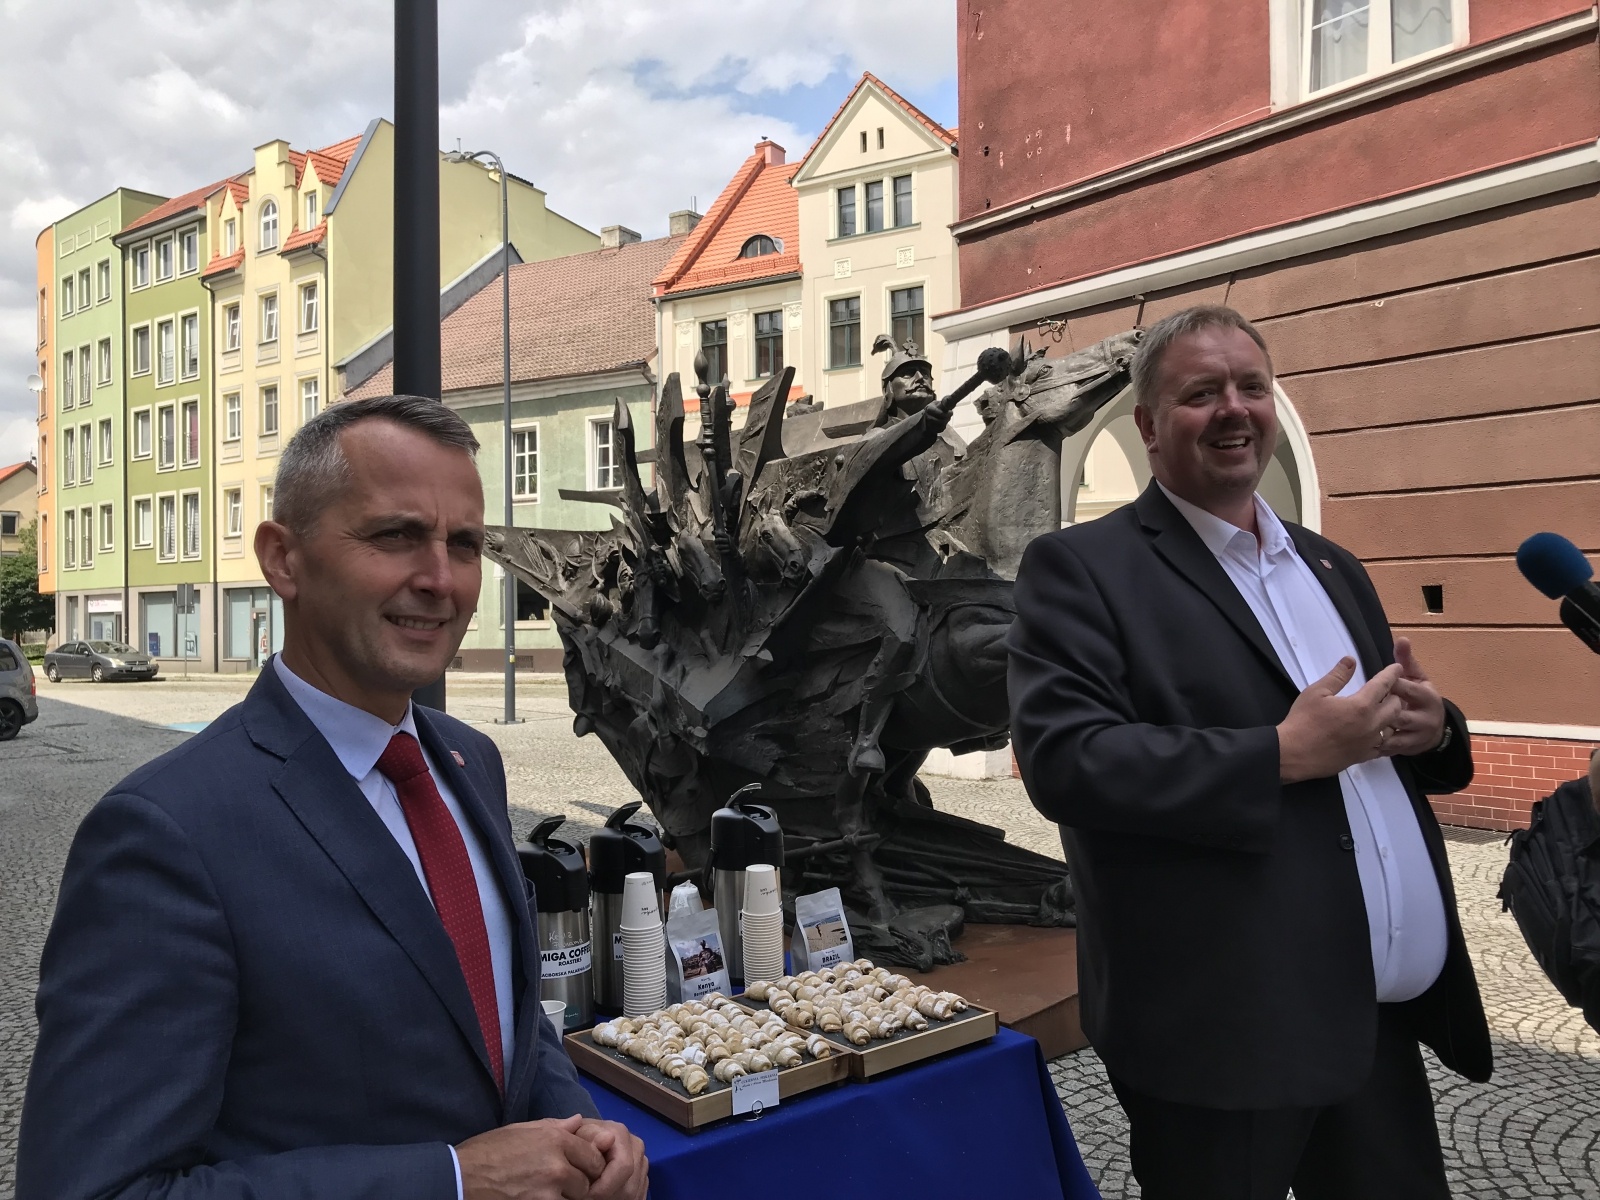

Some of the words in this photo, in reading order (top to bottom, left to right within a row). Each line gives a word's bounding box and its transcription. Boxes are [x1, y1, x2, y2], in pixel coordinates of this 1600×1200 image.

[541, 952, 566, 962] MIGA
[558, 957, 582, 966] ROASTERS
[822, 953, 840, 963] BRAZIL
[541, 970, 567, 978] ACIBORSKA
[698, 981, 714, 990] Kenya
